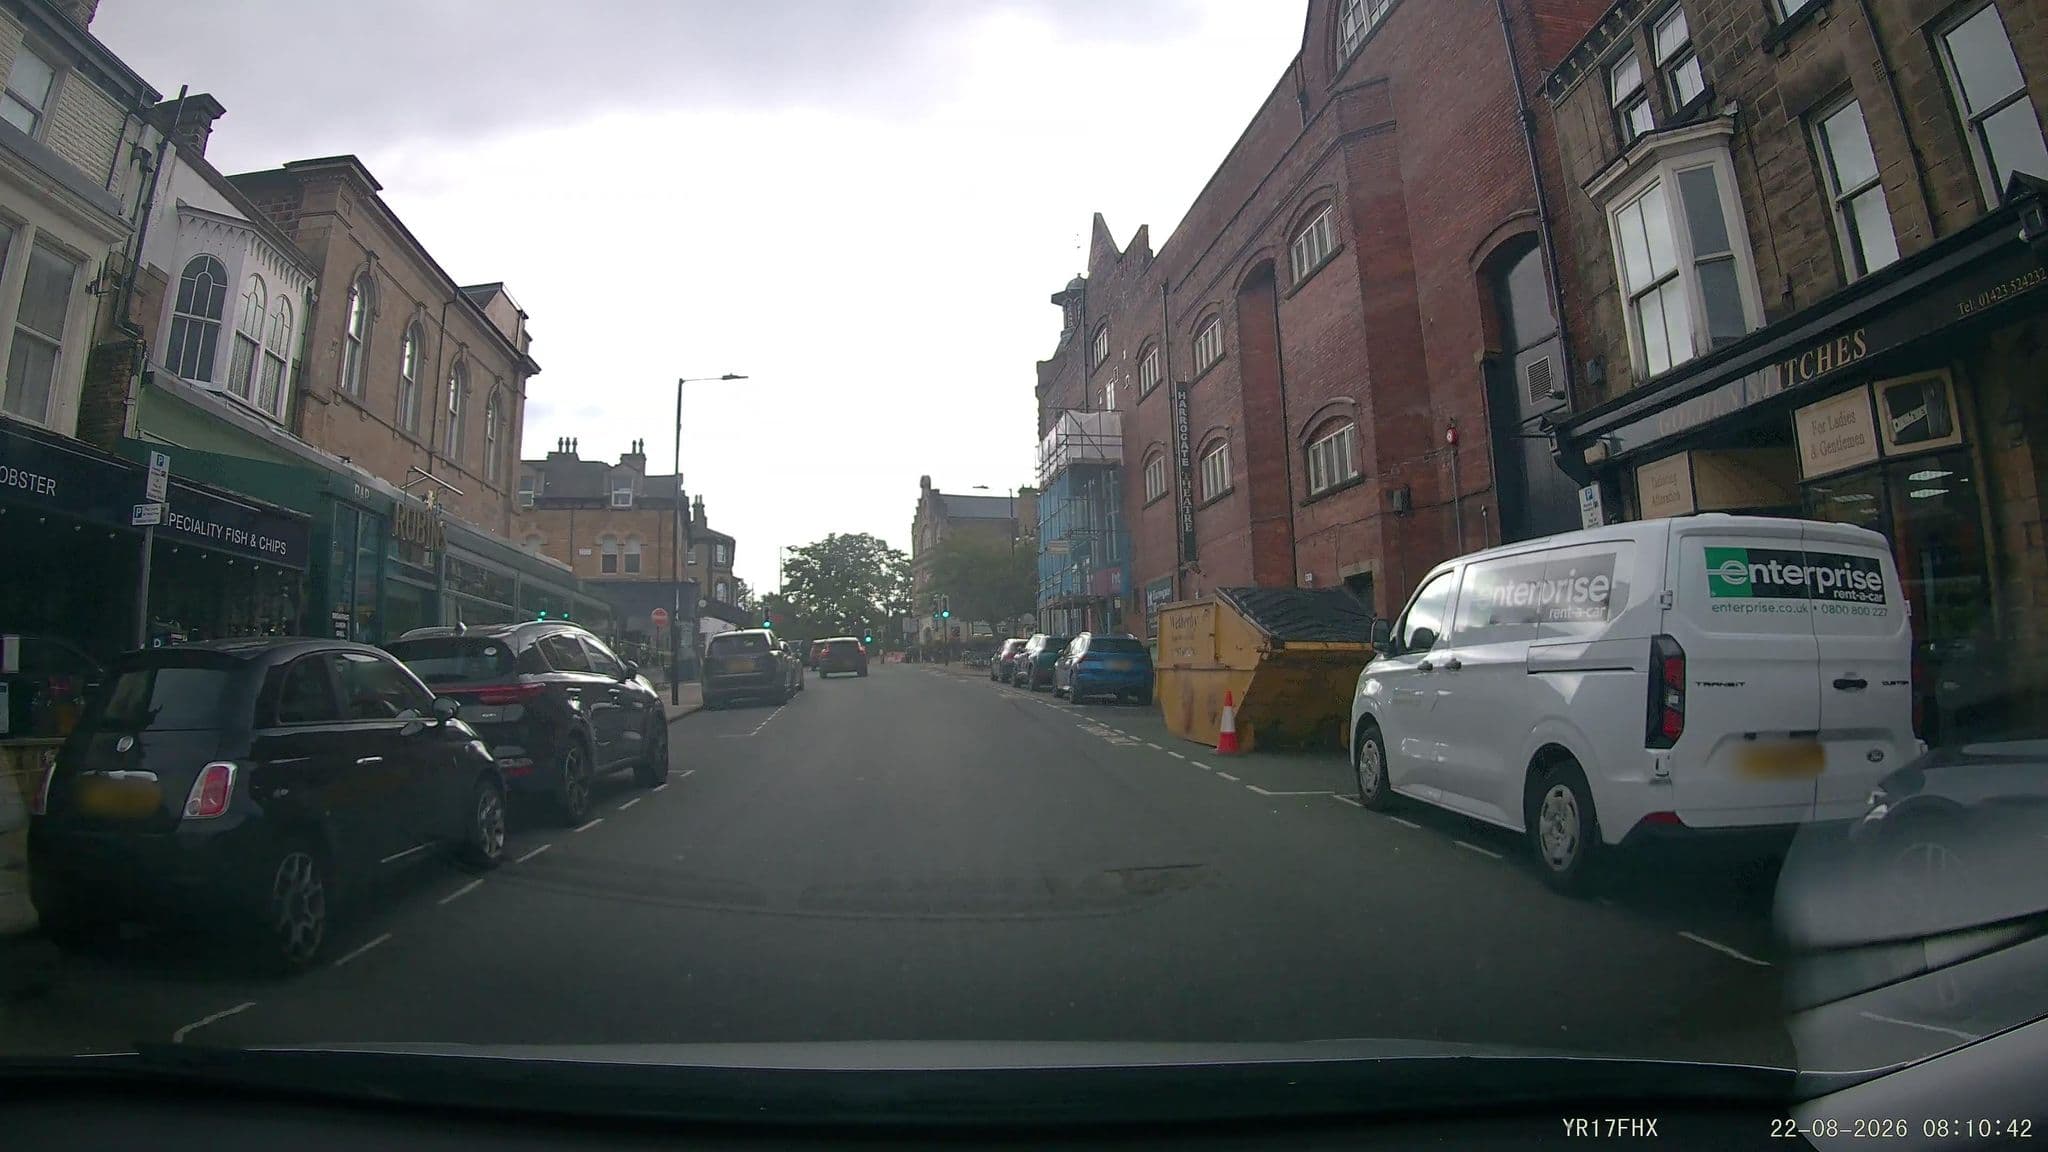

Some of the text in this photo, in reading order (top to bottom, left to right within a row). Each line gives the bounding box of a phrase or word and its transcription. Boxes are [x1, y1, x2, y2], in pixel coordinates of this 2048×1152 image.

[1978, 285, 2008, 307] 01423
[2010, 267, 2048, 295] 524232
[1748, 328, 1867, 404] STITCHES
[1811, 410, 1857, 435] For Ladies
[1819, 433, 1865, 457] Gentlemen
[157, 455, 164, 466] P
[1177, 391, 1193, 532] HARROGATE THEATRE
[0, 465, 56, 497] OBSTER
[1586, 489, 1593, 500] P
[135, 507, 142, 518] P
[166, 512, 224, 540] PECIALITY
[225, 527, 249, 546] FISH
[249, 534, 257, 548] &
[258, 536, 287, 555] CHIPS
[1708, 559, 1882, 594] enterprise
[1477, 568, 1611, 614] enterprise
[1833, 589, 1883, 603] rent-a-car
[1549, 605, 1606, 619] rent-a-car
[1711, 602, 1888, 617] enterprise.co.uk 0800 800 227
